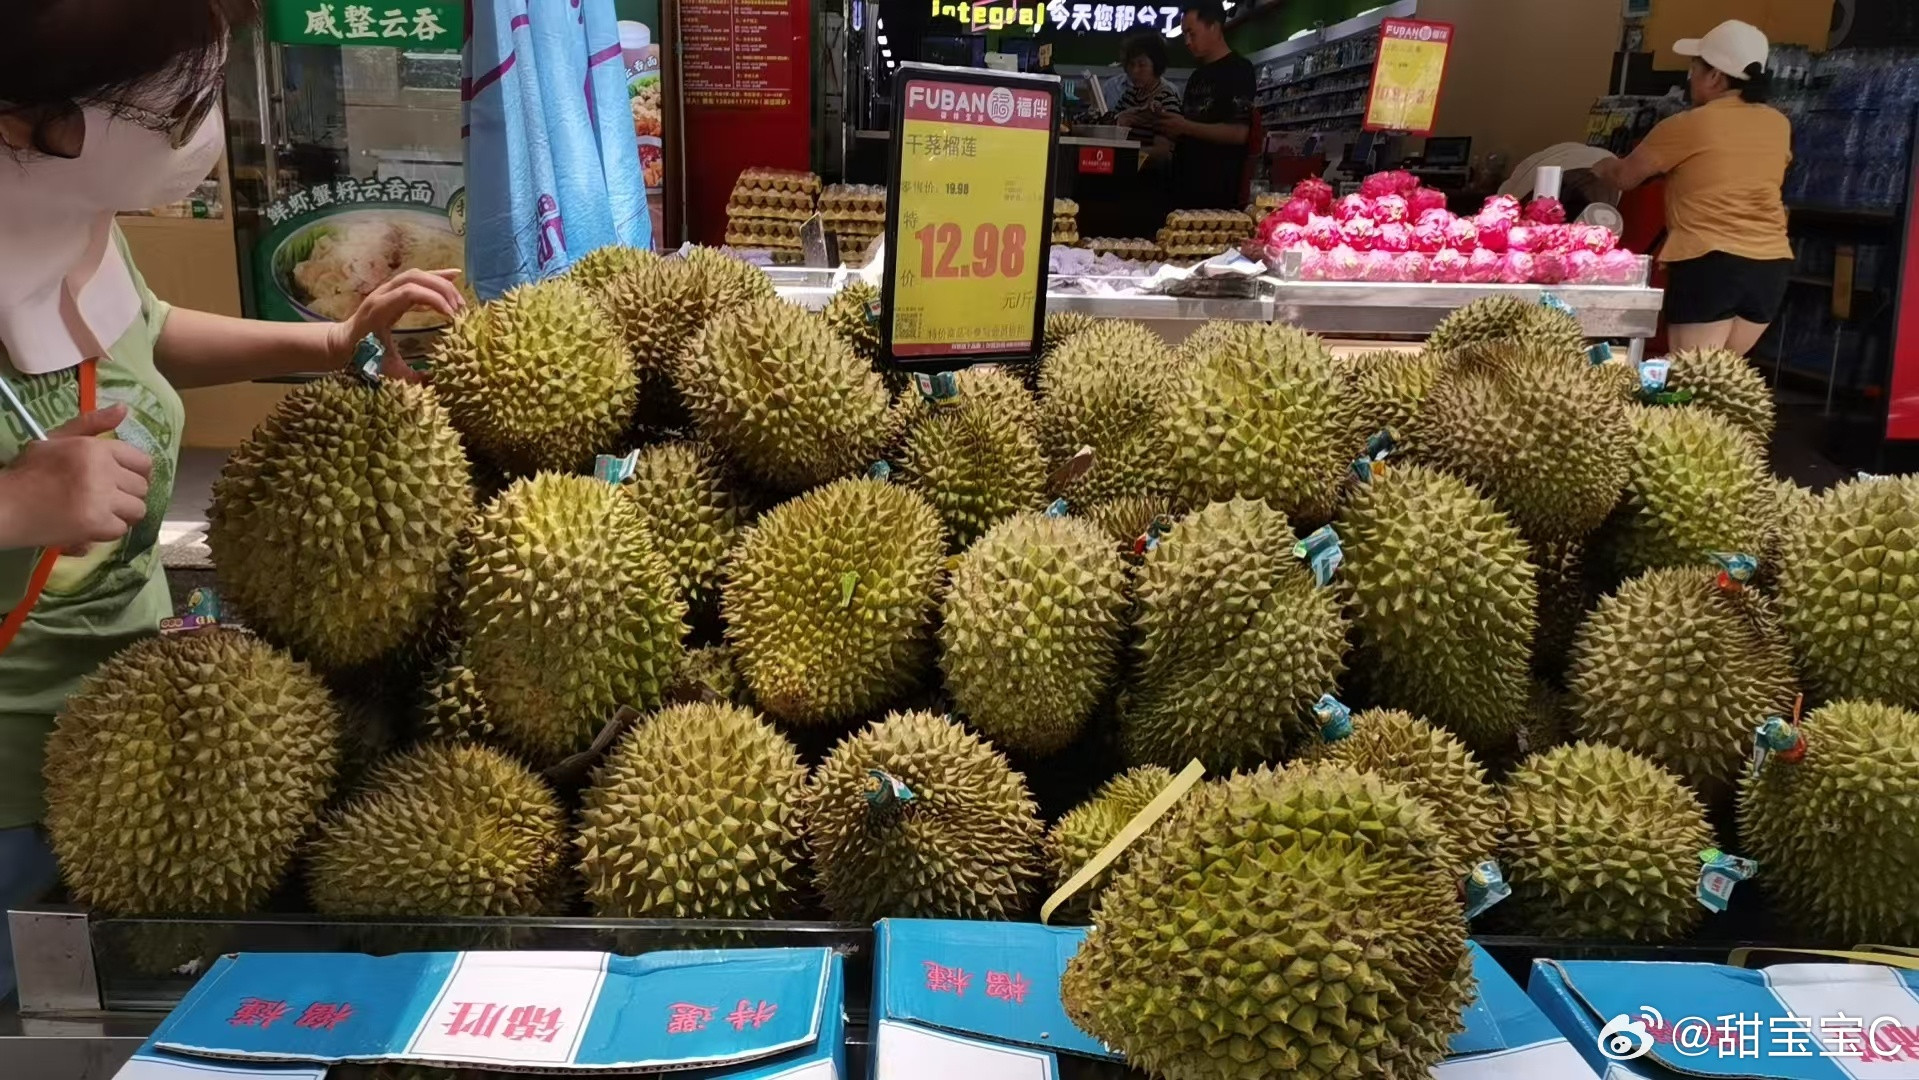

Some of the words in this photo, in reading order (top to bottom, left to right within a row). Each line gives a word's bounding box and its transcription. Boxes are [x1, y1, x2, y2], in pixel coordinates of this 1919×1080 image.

[303, 2, 447, 41] 威整云吞
[907, 86, 986, 113] FUBAN
[1016, 96, 1048, 119] 福伴
[266, 179, 433, 226] 鲜虾蟹籽云吞面
[946, 183, 969, 195] 19.98
[914, 222, 1026, 279] 12.98
[1002, 291, 1035, 311] 元/斤
[443, 1000, 567, 1043] 锦胜
